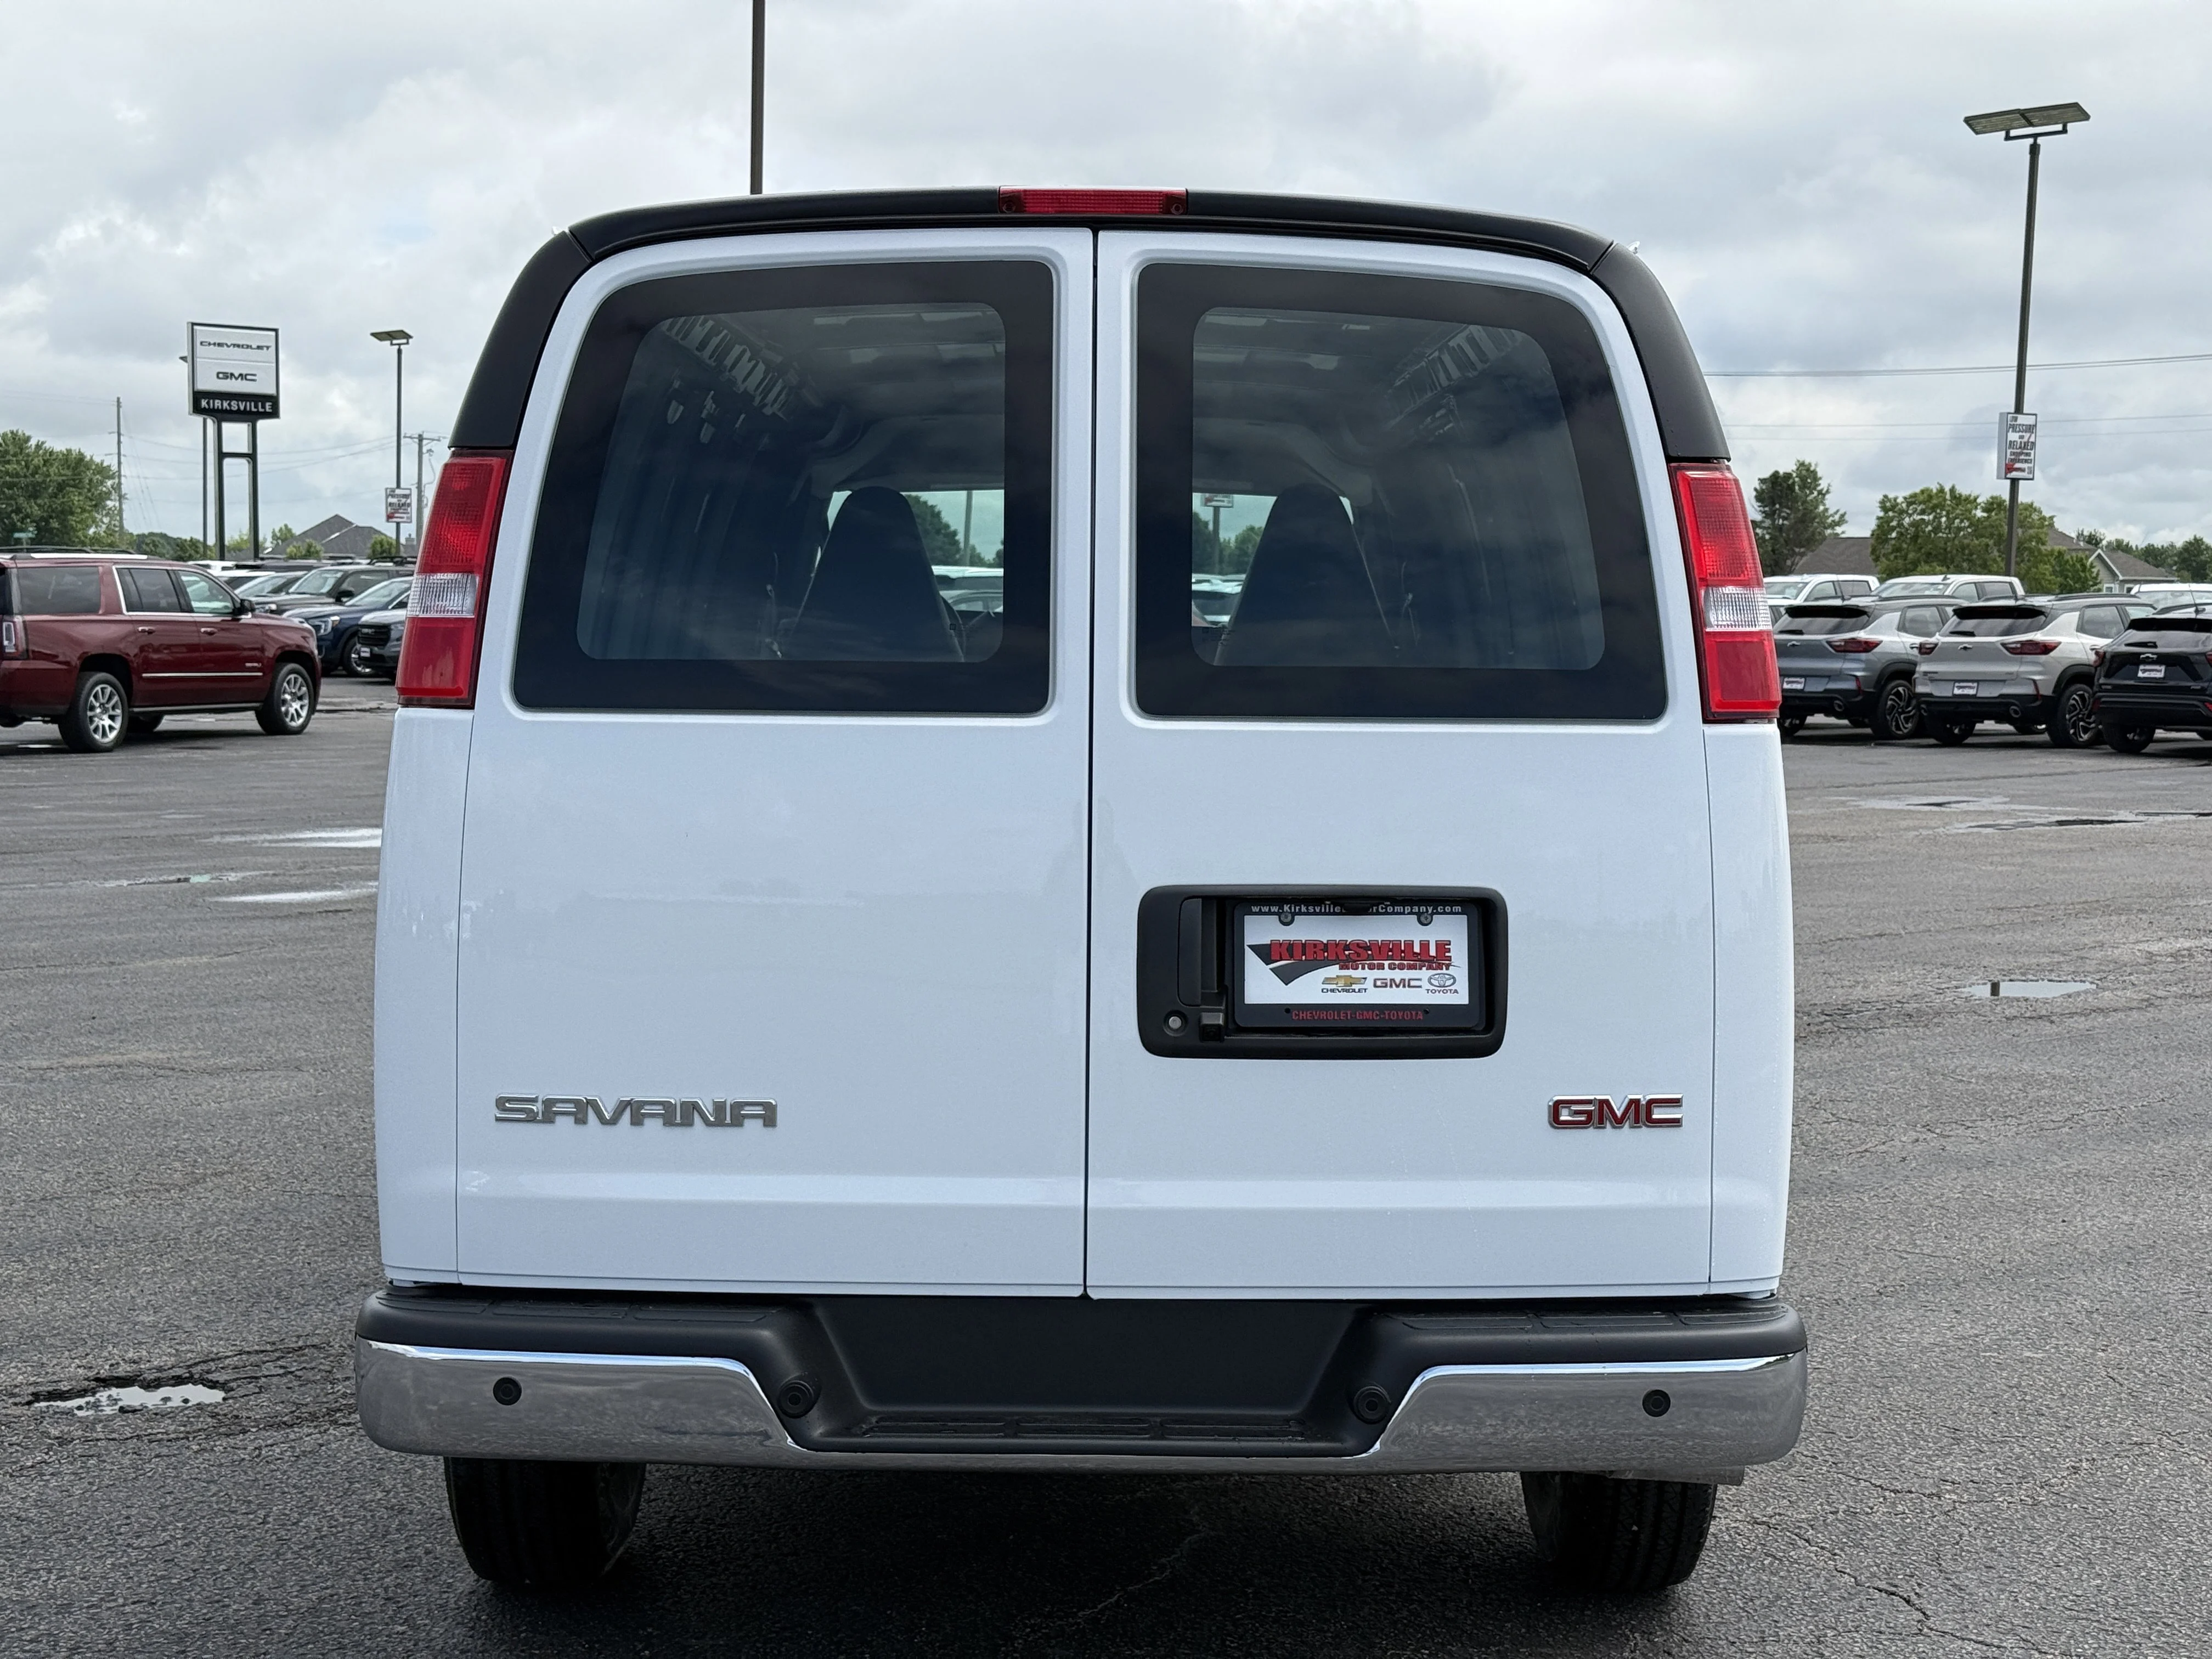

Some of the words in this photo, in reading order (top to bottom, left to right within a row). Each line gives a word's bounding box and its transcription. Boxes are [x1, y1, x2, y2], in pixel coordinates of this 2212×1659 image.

[200, 341, 272, 351] CHEVROLET
[216, 371, 257, 382] GMC
[201, 398, 273, 413] KIRKSVILLE
[2008, 423, 2035, 434] PRESSURE
[2008, 440, 2035, 450] RELAXED
[1251, 904, 1462, 915] www.KirksvillerCompany.com
[1269, 939, 1452, 962] KIRKSVILLE
[1339, 962, 1385, 970] MOTOR
[1388, 962, 1452, 970] COMPANY
[1373, 978, 1423, 989] GMC
[1291, 1010, 1424, 1020] CHEVROLET-GMC-TOYOTA
[495, 1093, 777, 1127] SAVANA
[1548, 1093, 1684, 1129] GMC
